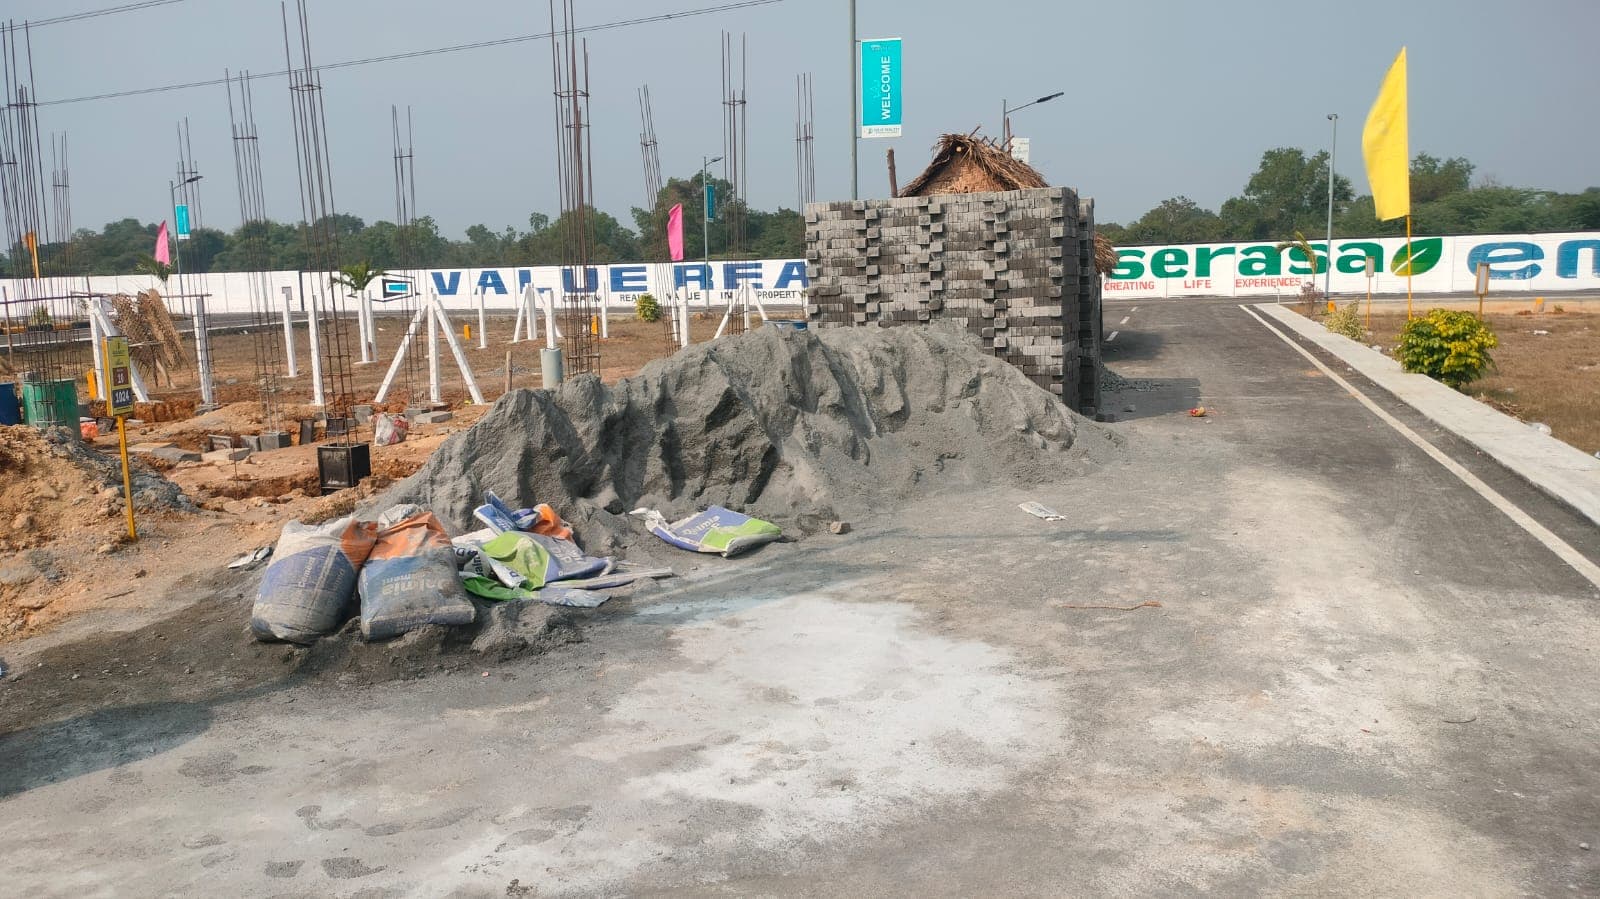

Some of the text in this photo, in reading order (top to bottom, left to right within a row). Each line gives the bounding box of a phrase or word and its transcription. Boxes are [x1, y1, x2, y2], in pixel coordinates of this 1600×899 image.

[881, 55, 891, 120] WELCOME
[1110, 242, 1383, 279] serasa
[431, 266, 647, 295] VALUE
[1104, 277, 1302, 291] CREATING LIFE EXPERIENCES
[757, 290, 807, 299] PROPERTY
[115, 390, 130, 403] 1024
